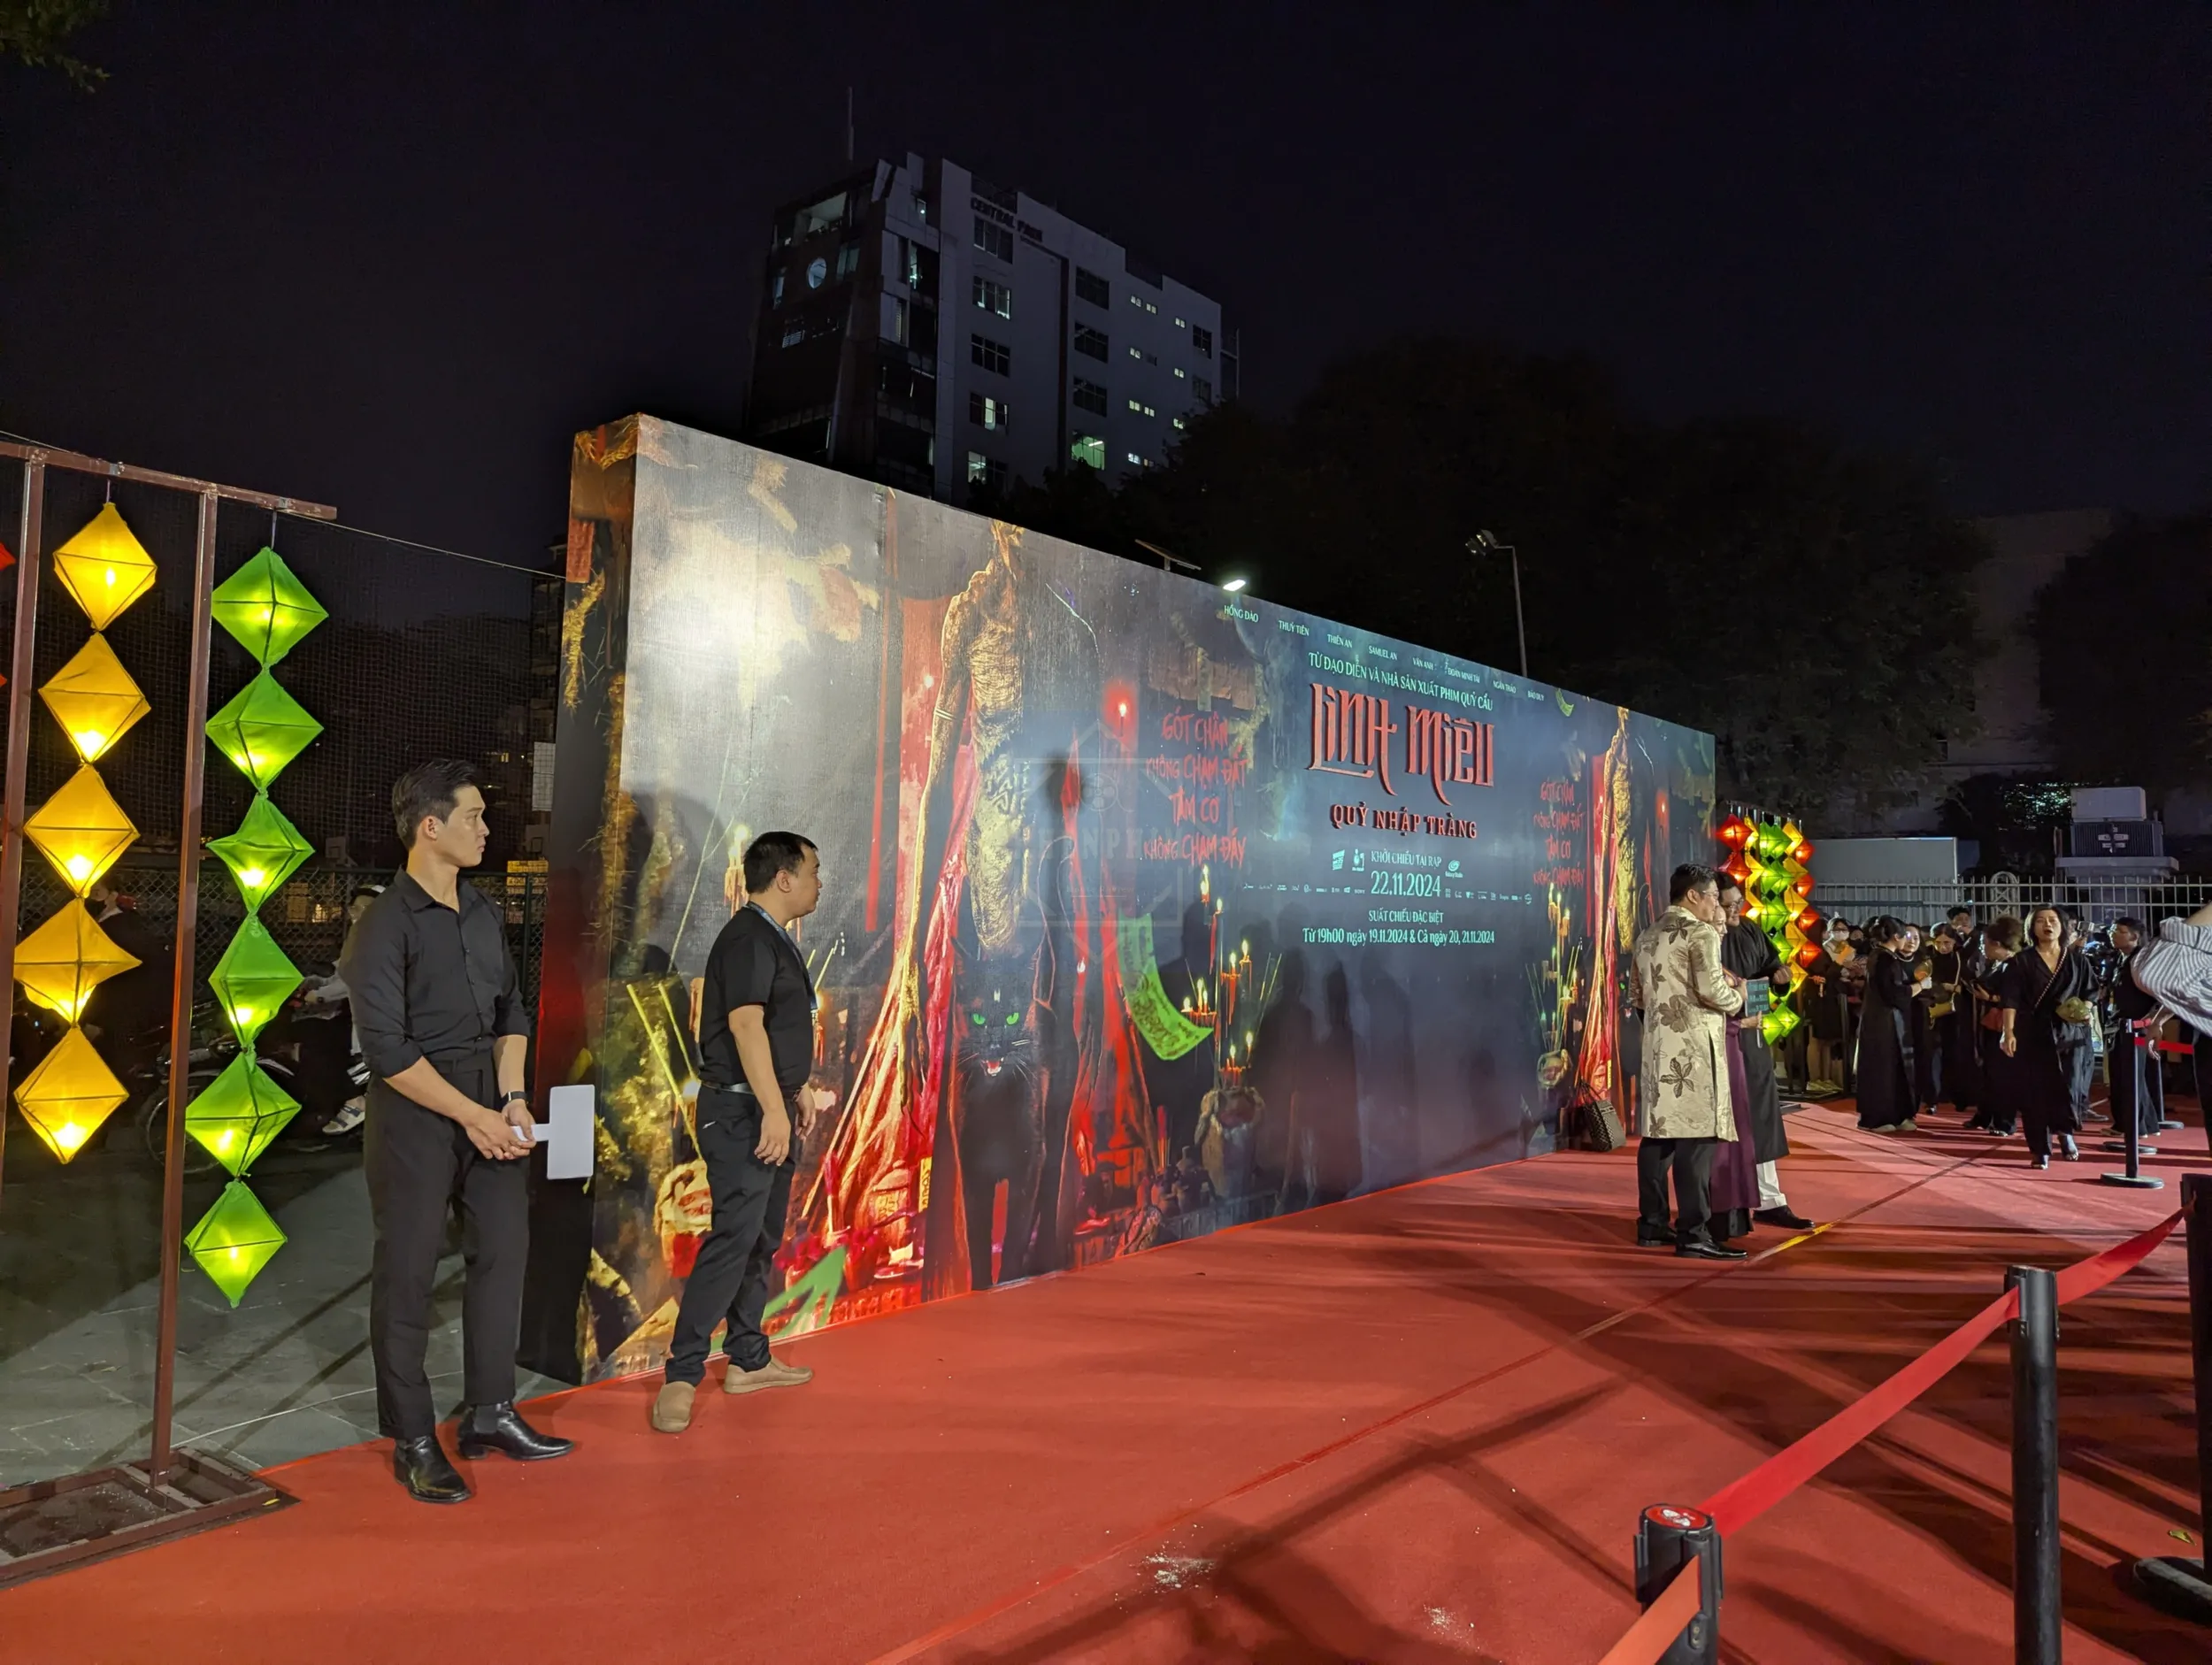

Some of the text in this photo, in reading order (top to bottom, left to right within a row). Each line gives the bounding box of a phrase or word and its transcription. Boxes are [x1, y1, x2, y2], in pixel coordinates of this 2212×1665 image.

[1244, 610, 1258, 622] ĐÀO
[1344, 639, 1353, 648] AN
[1368, 646, 1389, 659] SAMUEL
[1389, 651, 1397, 660] AN
[1308, 651, 1323, 668] TỪ
[1324, 656, 1344, 674] ĐẠO
[1346, 658, 1366, 679] DIỄN
[1368, 667, 1380, 683] VÀ
[1381, 670, 1399, 687] NHÀ
[1401, 675, 1417, 692] SẢN
[1417, 680, 1439, 697] XUẤT
[1440, 686, 1460, 703] PHIM
[1461, 691, 1477, 708] QUỶ
[1162, 706, 1228, 750] GÓT CHÂN
[1184, 754, 1218, 789] CHẠM
[1330, 801, 1478, 839] QUỶ NHẬP TRÀNG
[1144, 835, 1179, 862] KHÔNG
[1371, 848, 1442, 870] KHỞI CHIẾU TẠI RẠP
[1371, 871, 1440, 897] 22.11.2024
[1369, 908, 1444, 925] SUẤT CHIẾU ĐẶC BIỆT
[1302, 927, 1494, 947] Từ 19h00 ngày 19.11.2024 & Cả ngày 20, 21.11.2024
